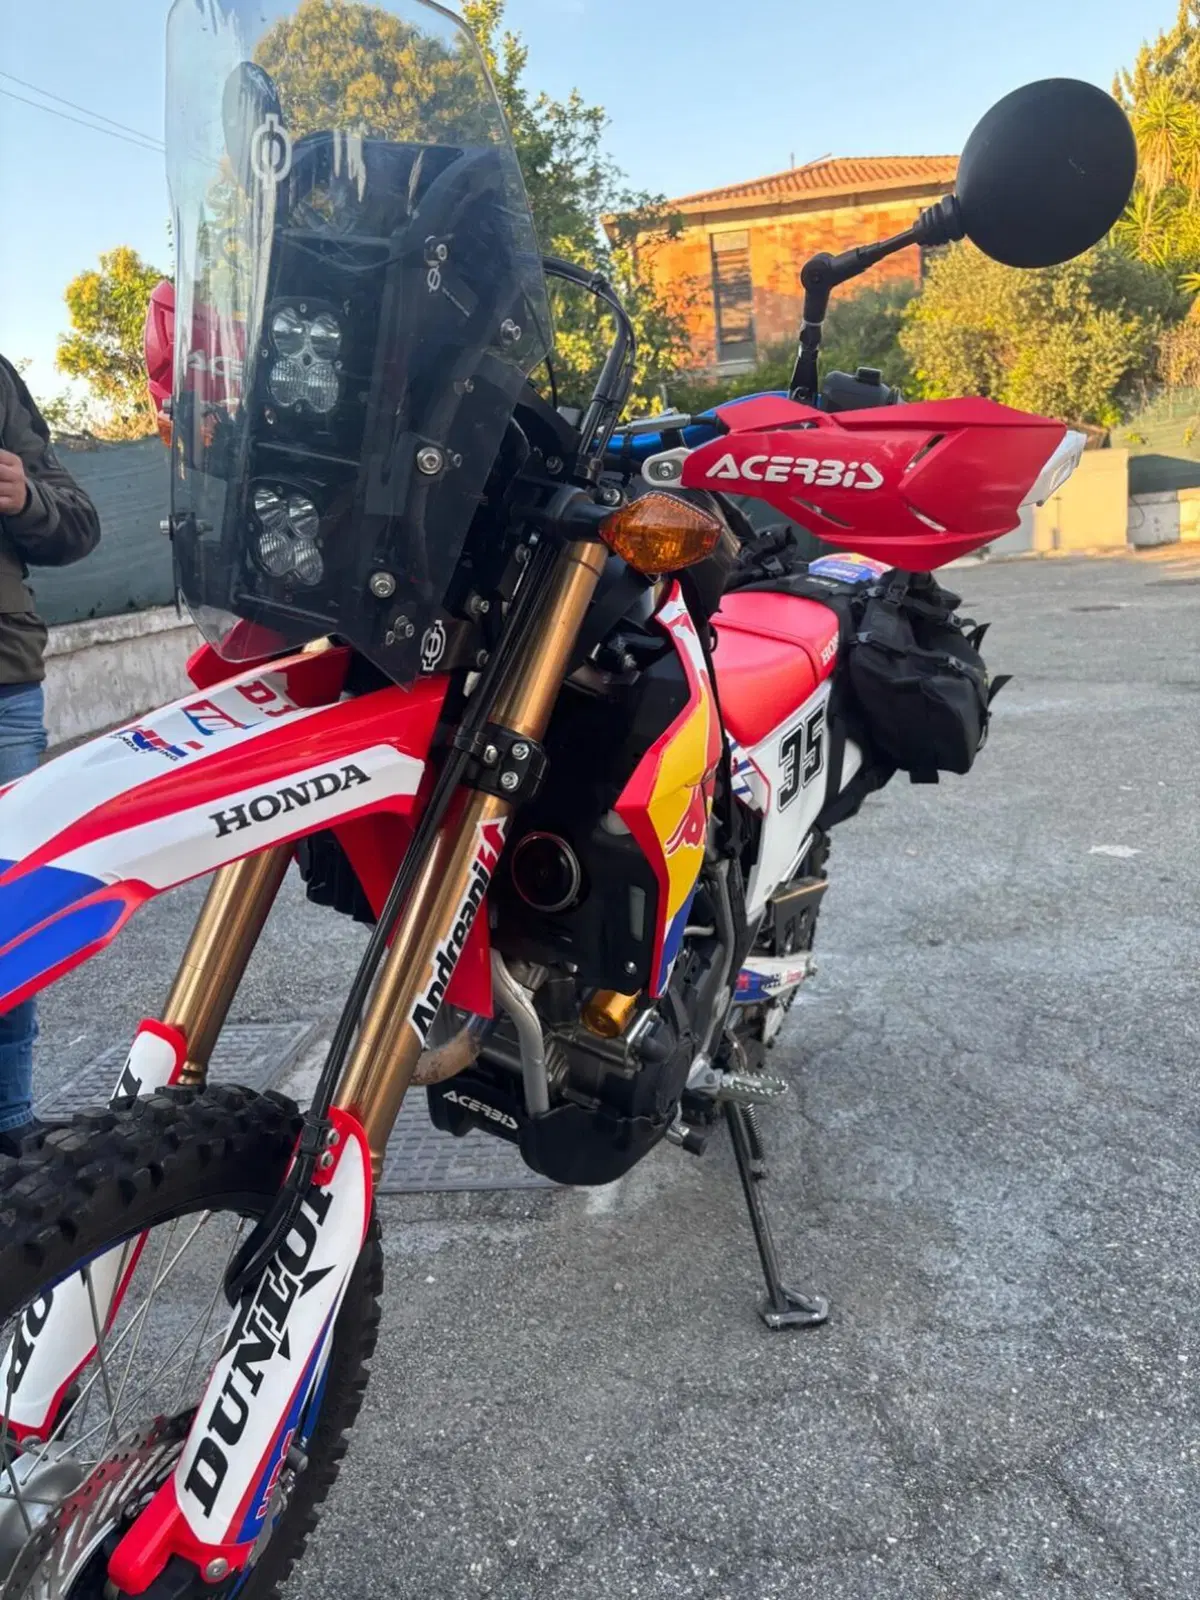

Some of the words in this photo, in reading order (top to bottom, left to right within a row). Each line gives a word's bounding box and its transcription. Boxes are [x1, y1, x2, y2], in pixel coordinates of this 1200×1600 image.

[208, 764, 371, 838] HONDA
[777, 699, 825, 813] 35
[411, 859, 492, 1040] Andreani
